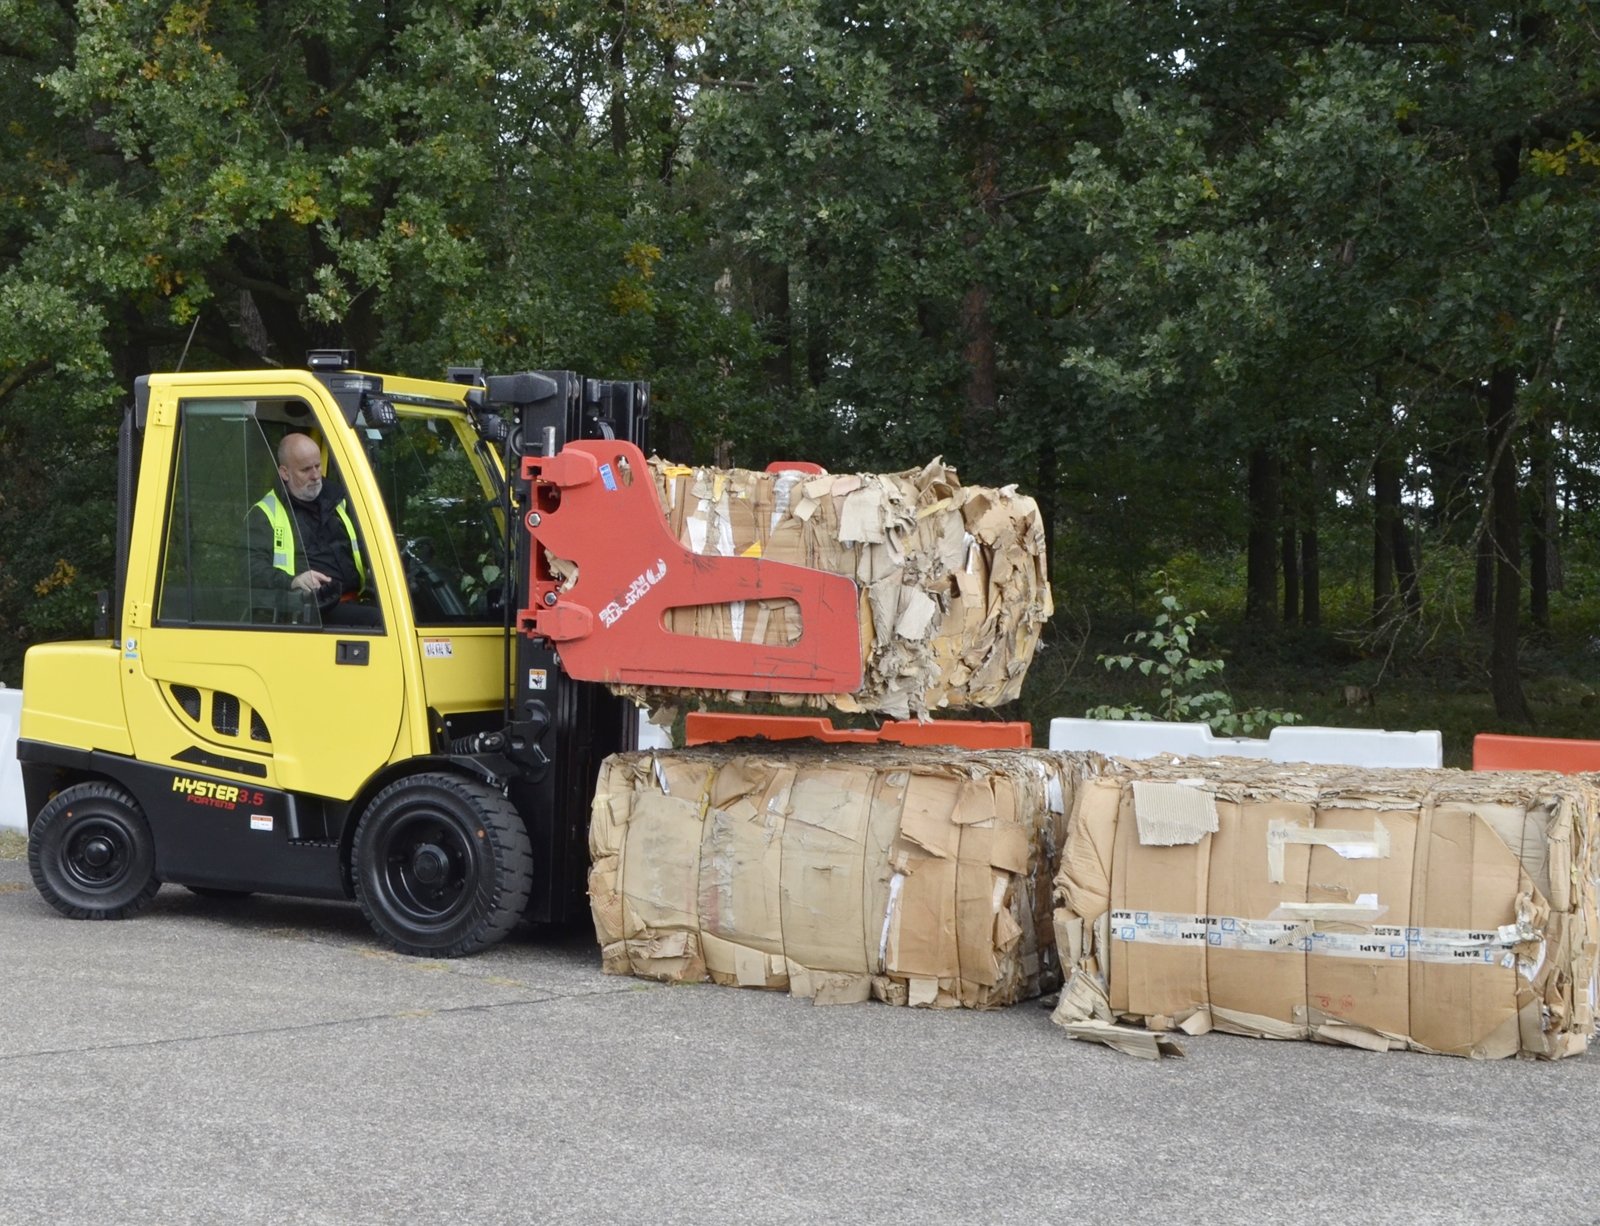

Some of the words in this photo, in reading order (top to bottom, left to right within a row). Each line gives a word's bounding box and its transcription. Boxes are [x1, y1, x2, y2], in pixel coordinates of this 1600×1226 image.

[173, 777, 238, 802] HYSTER
[239, 790, 263, 805] 3.5
[1374, 928, 1401, 936] ZAPI
[1359, 944, 1386, 952] ZAPI
[1453, 950, 1480, 958] ZAPI
